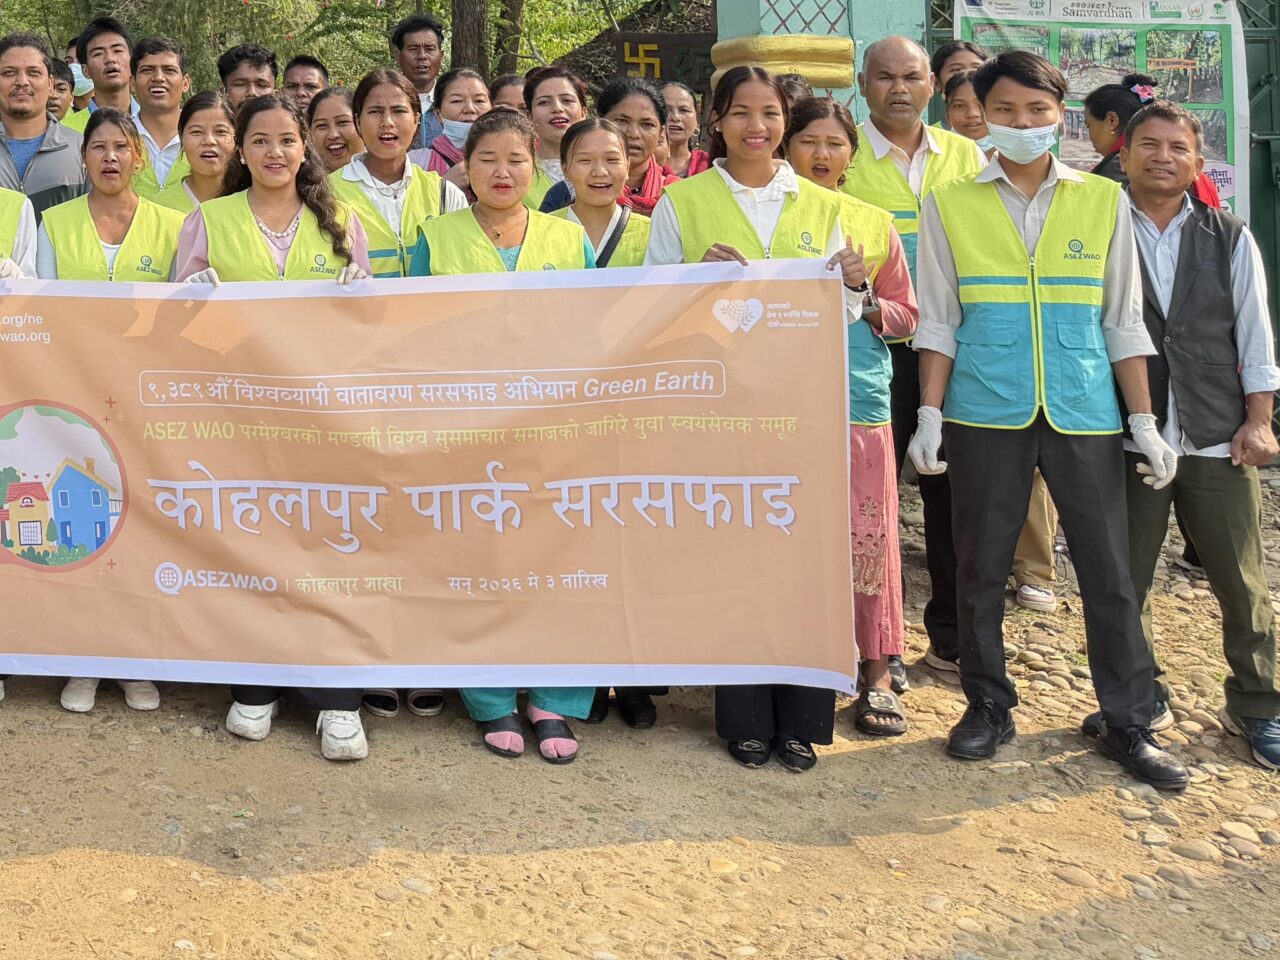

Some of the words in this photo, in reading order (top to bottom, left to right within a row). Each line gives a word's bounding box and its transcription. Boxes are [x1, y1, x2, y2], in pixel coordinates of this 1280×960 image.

[1062, 6, 1133, 18] Samvardhan
[1063, 253, 1101, 261] ASEZWAO
[136, 266, 163, 276] ASEZWAO
[309, 266, 337, 275] ASEZWAO
[334, 384, 413, 406] वातावरण
[418, 382, 497, 404] सरसफाइ
[504, 375, 578, 402] अभियान
[583, 376, 647, 398] Green
[654, 370, 715, 391] Earth
[143, 421, 188, 440] ASEZ
[192, 421, 235, 440] WAO
[239, 420, 322, 445] परमेश्वरको
[326, 426, 381, 449] मण्डली
[386, 424, 429, 448] विश्व
[433, 428, 508, 453] सुसमाचार
[632, 416, 665, 440] युवा
[668, 410, 754, 433] स्वयंसेवक
[758, 415, 798, 440] समूह
[146, 460, 388, 554] कोहलपुर
[401, 460, 530, 534] पार्क
[545, 475, 802, 537] सरसफाइ
[183, 569, 278, 592] ASEZWAO
[295, 572, 360, 598] कोहलपुर
[364, 576, 403, 592] शाखा
[446, 576, 475, 597] सन्
[478, 577, 523, 593] २०२६
[527, 571, 540, 590] मे
[545, 575, 556, 590] ३
[560, 569, 609, 590] तारिख
